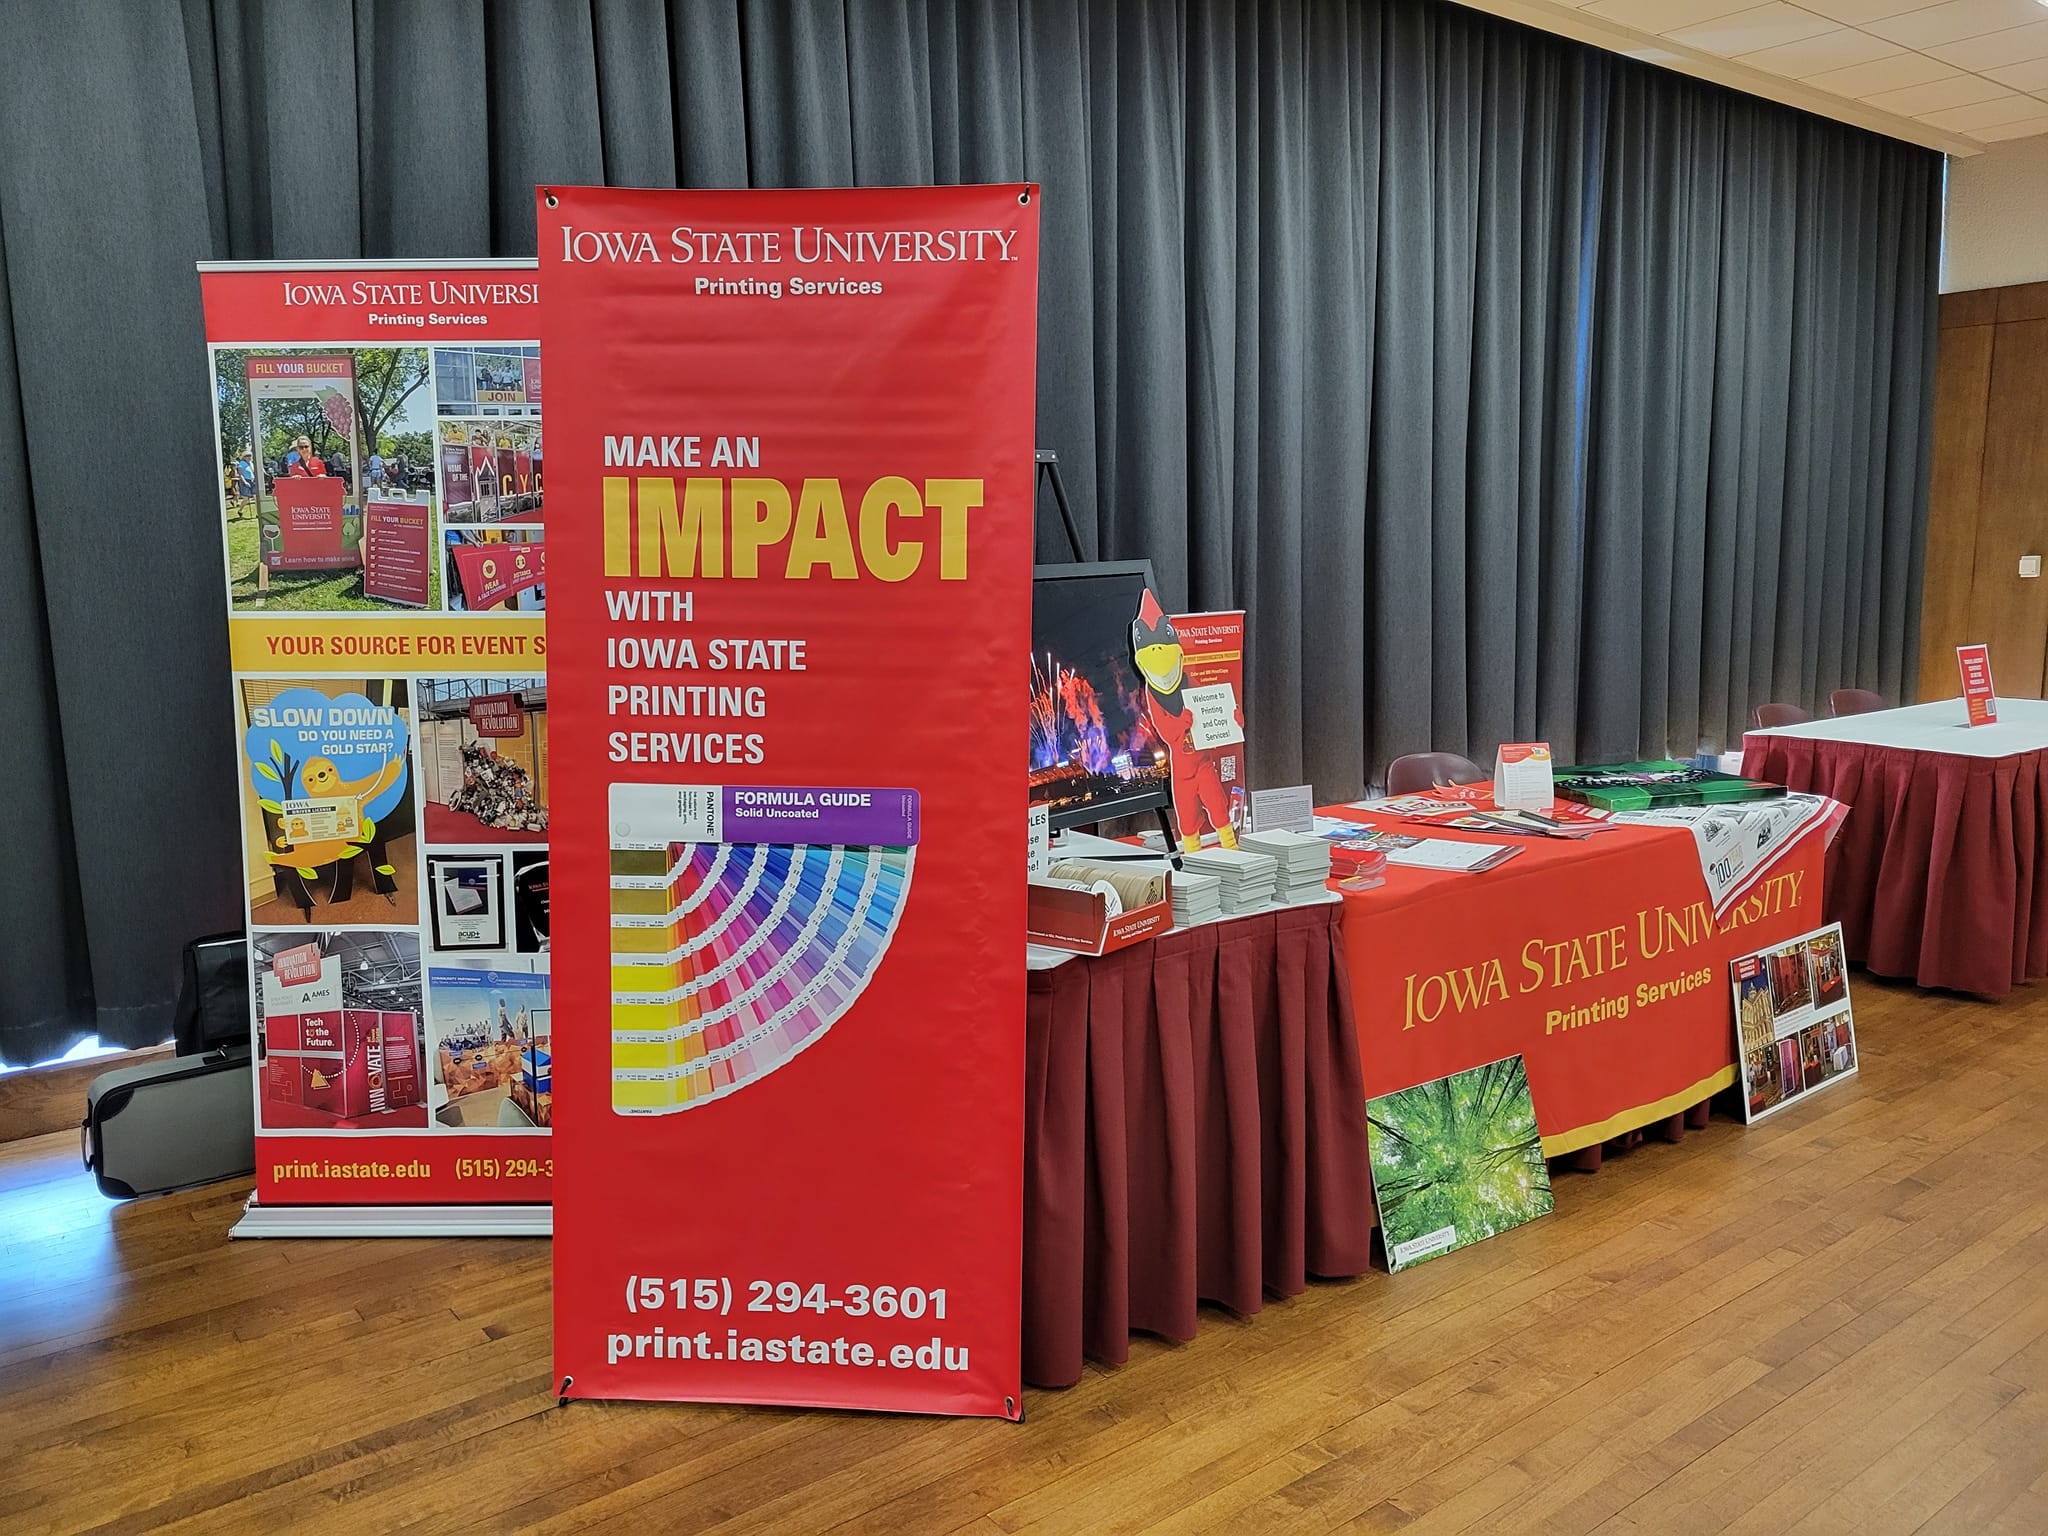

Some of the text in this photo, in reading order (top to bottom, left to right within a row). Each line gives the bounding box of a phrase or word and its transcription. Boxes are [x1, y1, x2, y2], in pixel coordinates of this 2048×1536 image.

[561, 226, 661, 263] IOWA
[671, 226, 781, 264] STATE
[283, 281, 539, 306] IOWA STATE UNIVERSI
[695, 277, 882, 299] Printing Services
[368, 312, 487, 327] Printing Services
[255, 363, 344, 374] FILL YOUR BUCKET
[488, 392, 516, 402] JOIN
[604, 435, 760, 468] MAKE AN
[310, 505, 330, 513] STATE
[603, 475, 984, 582] IMPACT
[605, 590, 694, 622] WITH
[1190, 626, 1207, 637] STATE
[1208, 625, 1240, 636] UNIVERSITY
[266, 636, 546, 656] YOUR SOURCE FOR EVENT S
[607, 638, 807, 671] IOWA STATE
[608, 685, 766, 717] PRINTING
[1192, 693, 1219, 703] Welcome
[474, 701, 509, 716] INNOVATION
[1201, 706, 1223, 716] Printing
[253, 707, 393, 728] SLOW DOWN
[481, 716, 518, 730] REVOLUTION
[1202, 718, 1228, 729] and Copy
[298, 728, 394, 742] DO YOU NEED A
[1205, 729, 1231, 742] Services!
[321, 742, 394, 755] GOLD STAR?
[608, 732, 765, 764] SERVICES
[286, 801, 310, 809] IOWA
[735, 791, 871, 807] FORMULA GUIDE
[735, 808, 819, 819] Solid Uncoated
[458, 931, 480, 939] acup+
[284, 963, 316, 980] REVOLUTION
[1402, 959, 1510, 1032] IOWA
[1519, 925, 1628, 994] STATE
[311, 989, 330, 998] AMES
[1546, 992, 1630, 1036] Printing
[1635, 966, 1712, 1008] Services
[305, 1018, 324, 1027] Tech
[306, 1028, 329, 1037] to the
[306, 1037, 335, 1047] Future.
[273, 1158, 552, 1183] print.iastate.edu (515) 294-3
[625, 1275, 946, 1320] (515) 294-3601
[607, 1326, 969, 1371] print.iastate.edu
